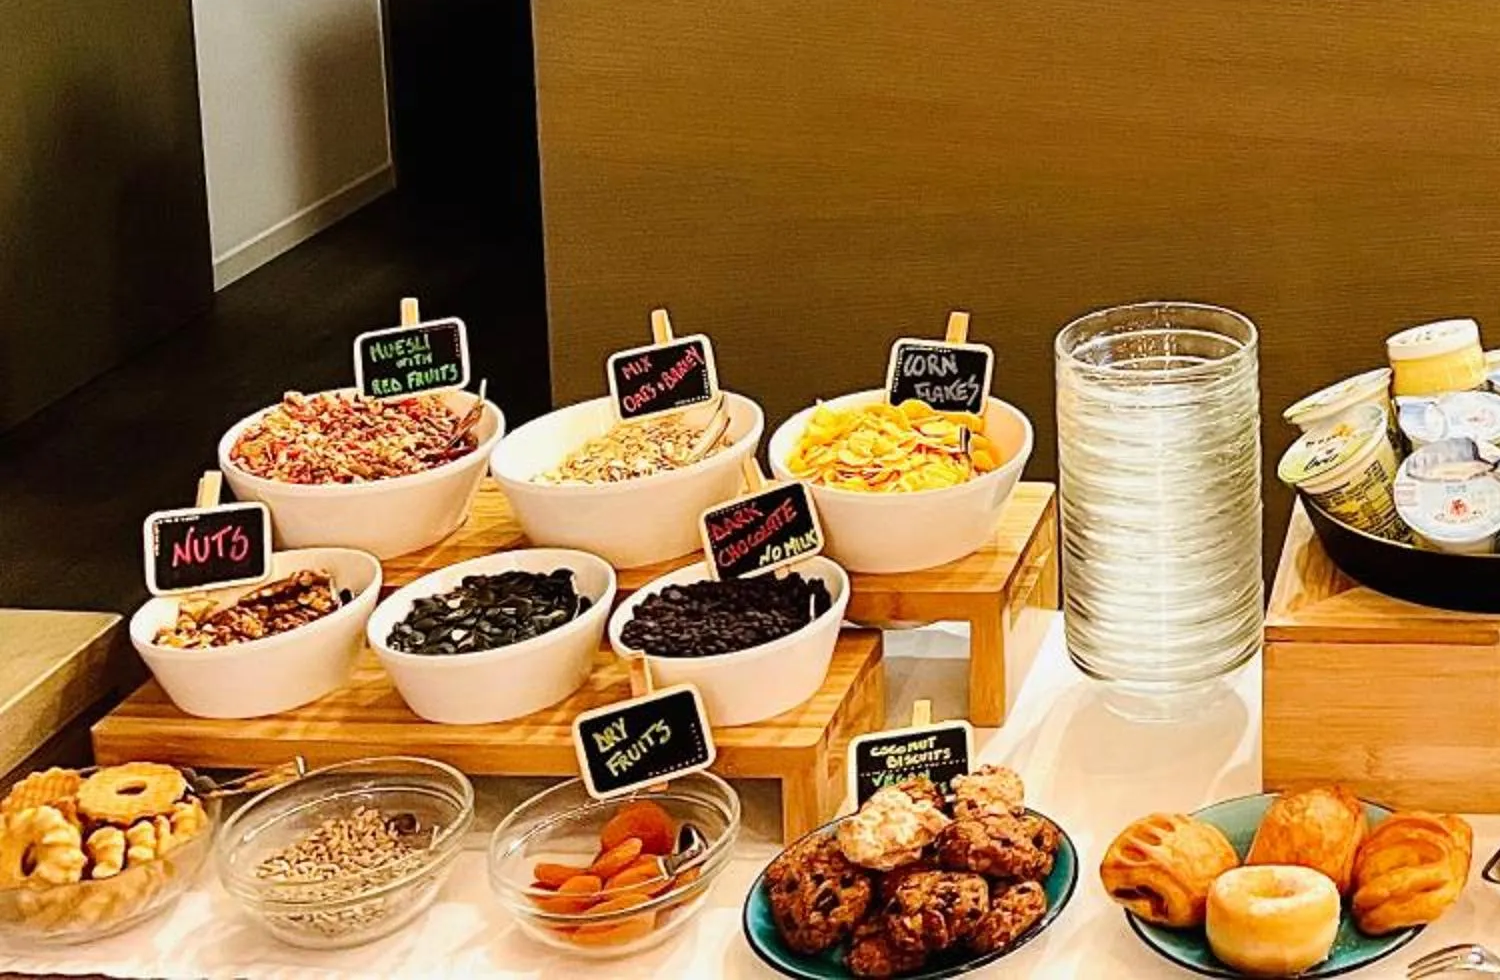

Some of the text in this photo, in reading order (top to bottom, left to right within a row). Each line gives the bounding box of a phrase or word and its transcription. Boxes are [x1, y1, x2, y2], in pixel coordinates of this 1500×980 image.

[369, 333, 431, 363] MUESLI
[903, 353, 958, 377] CORN
[371, 363, 458, 395] RED FRUITS
[622, 355, 653, 380] MIX
[660, 345, 705, 390] BARLEY
[914, 373, 980, 406] FLAKES
[709, 501, 765, 541] DARK
[718, 497, 797, 567] CHOCOLATE
[172, 526, 249, 567] NUTS
[759, 528, 819, 565] NO MILK
[592, 717, 628, 753] DRY
[605, 719, 671, 777] FRUITS
[870, 736, 937, 757] COCONUT
[886, 747, 951, 769] BISCUITS
